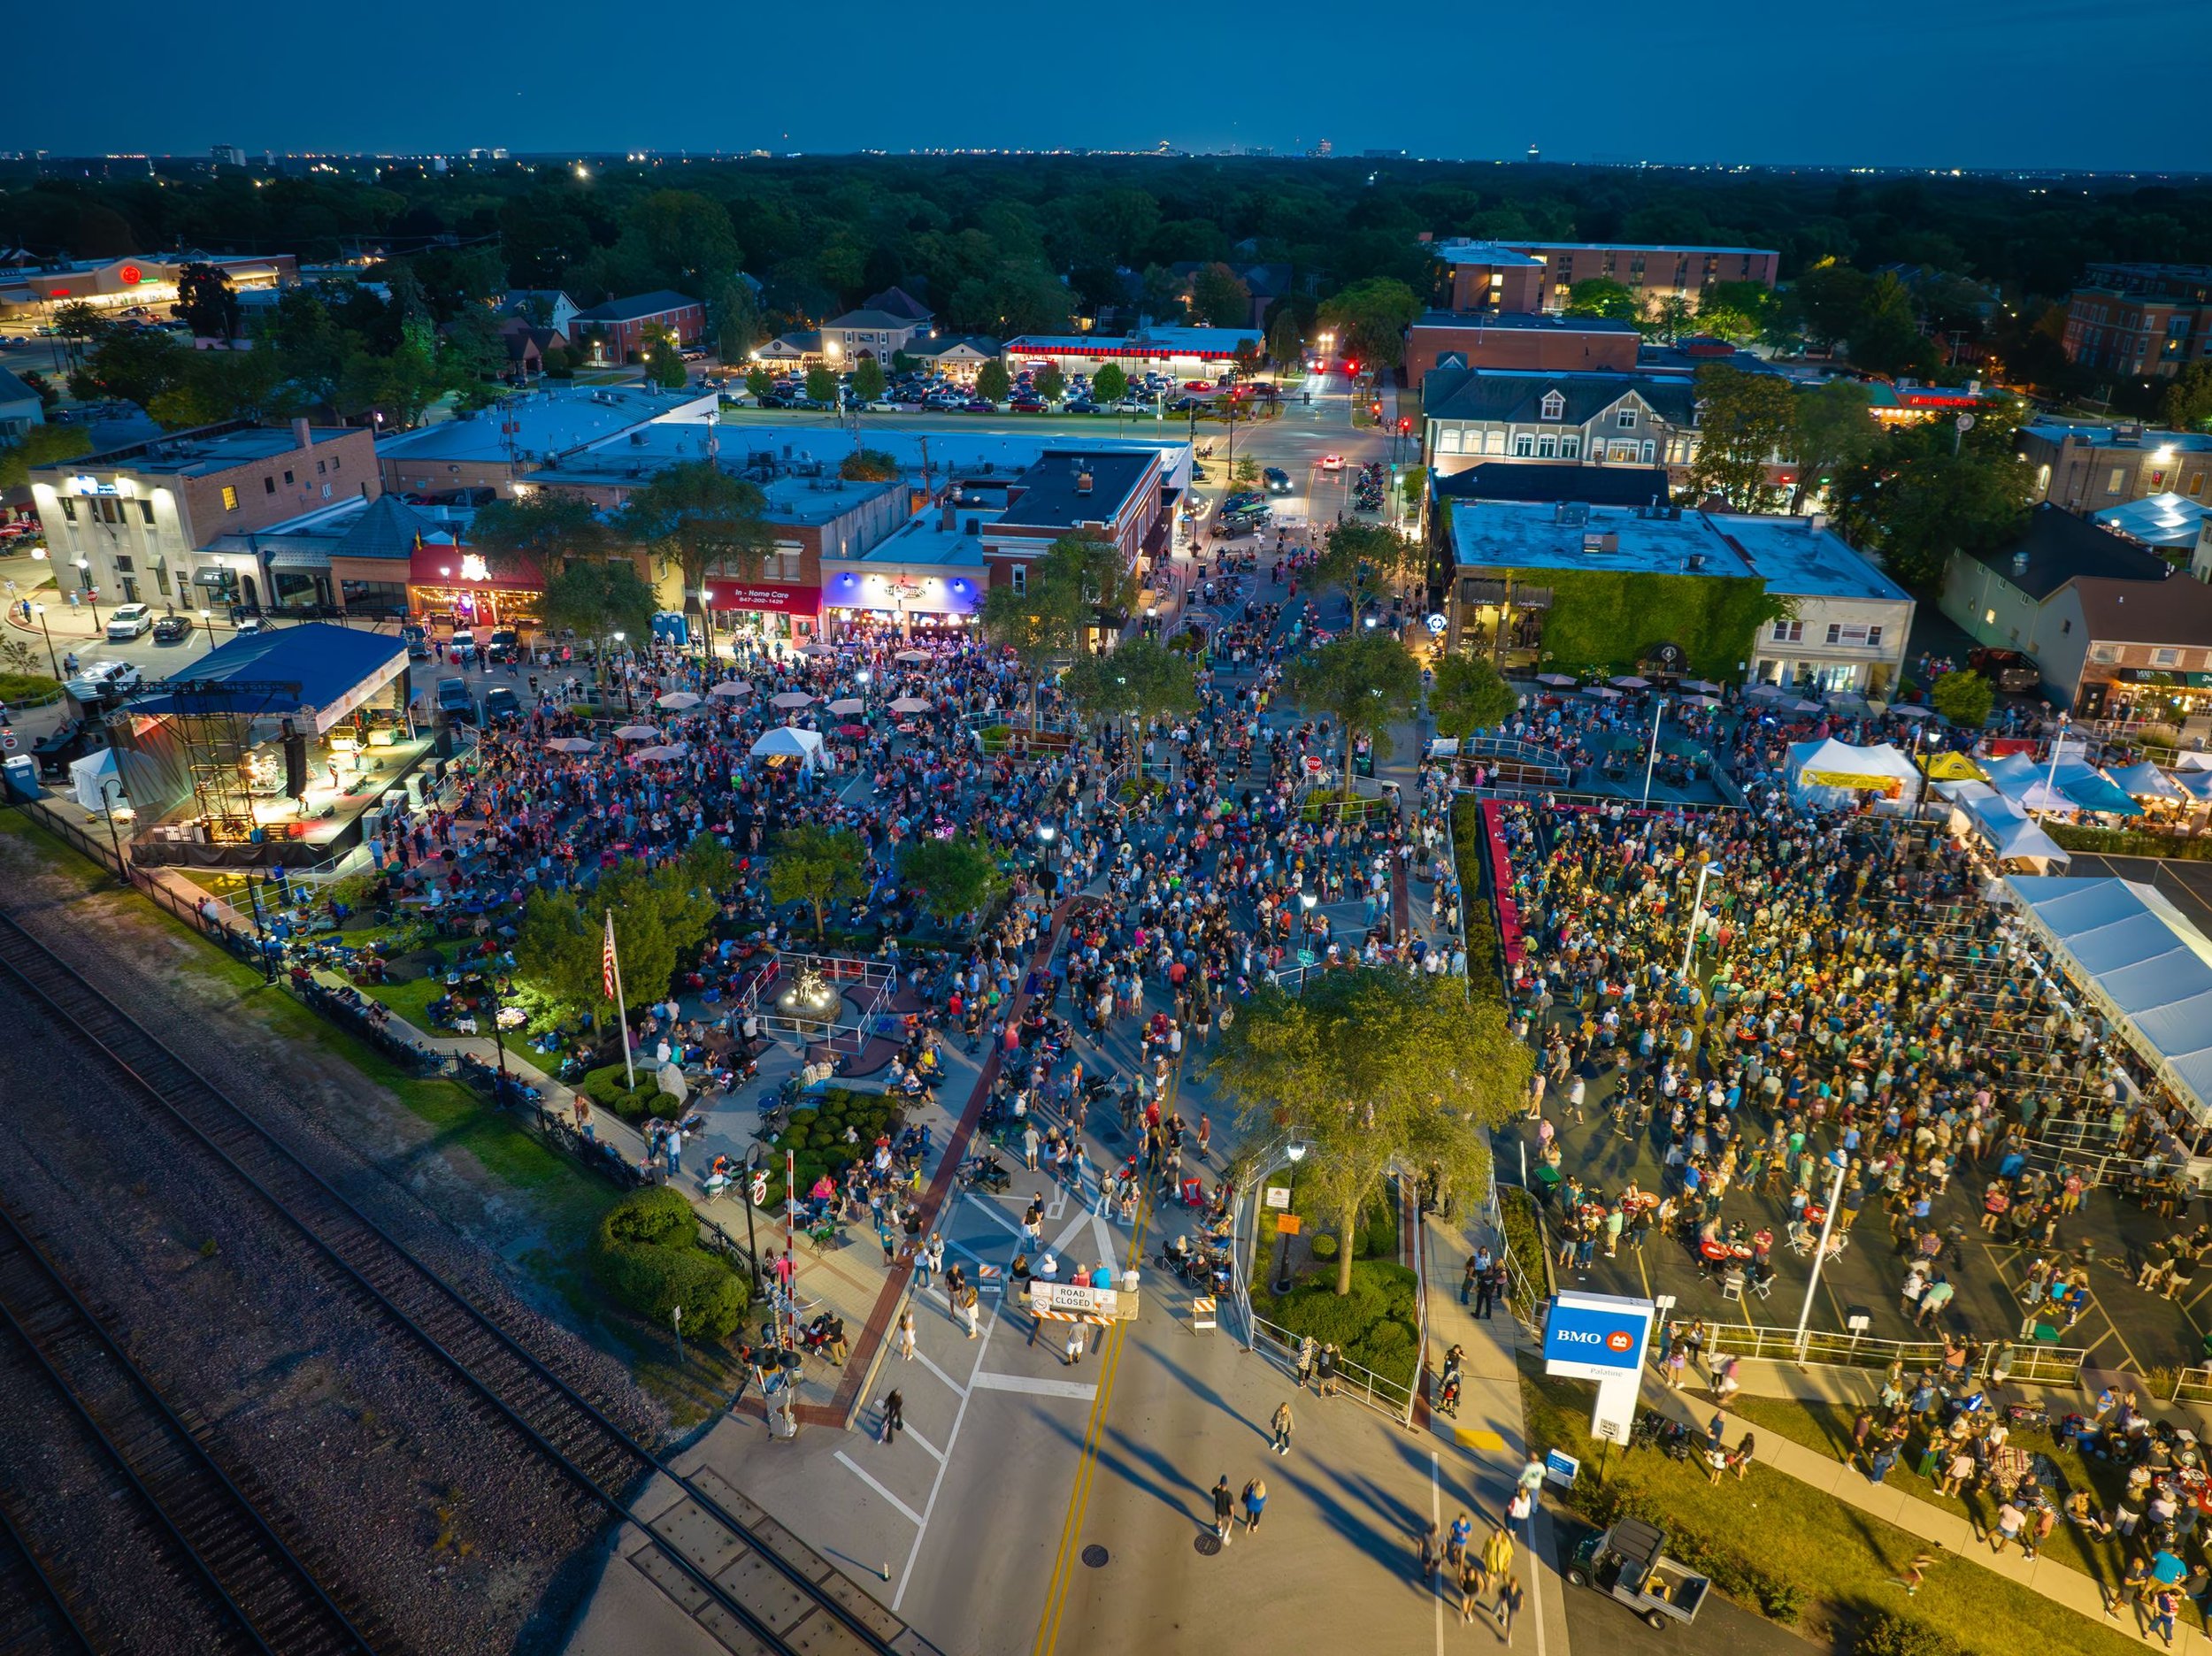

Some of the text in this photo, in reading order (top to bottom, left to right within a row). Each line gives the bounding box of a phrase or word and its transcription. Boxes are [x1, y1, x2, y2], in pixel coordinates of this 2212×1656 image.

[1061, 1289, 1086, 1298] ROAD
[1056, 1297, 1090, 1307] CLOSED
[1557, 1330, 1601, 1344] BMO
[1590, 1368, 1624, 1377] Palatine
